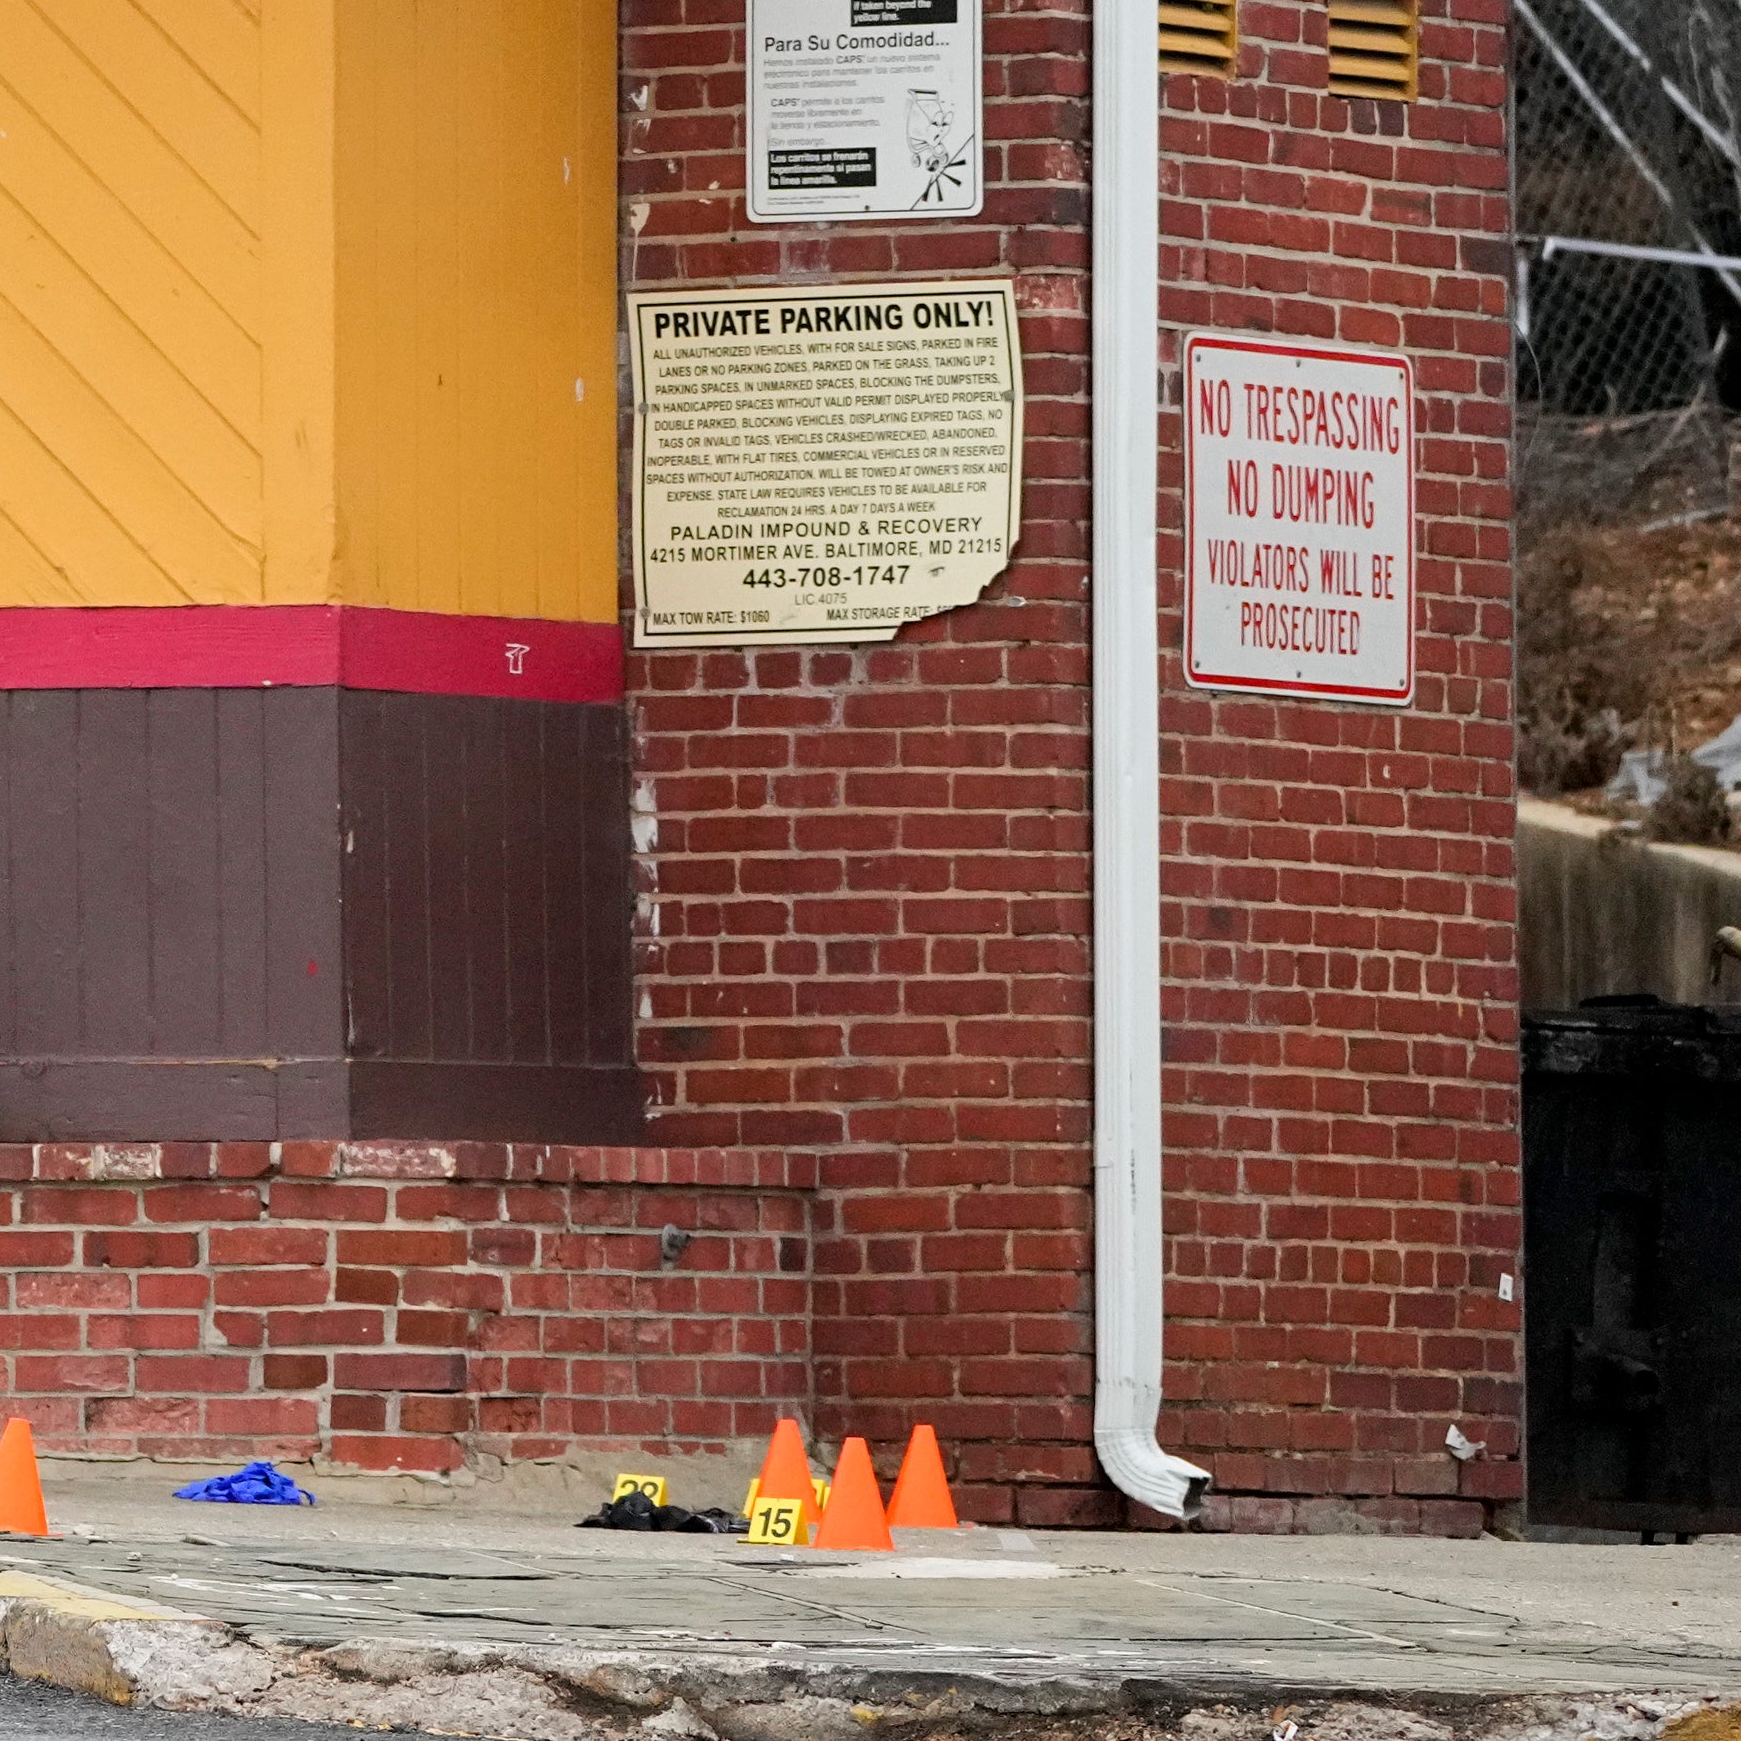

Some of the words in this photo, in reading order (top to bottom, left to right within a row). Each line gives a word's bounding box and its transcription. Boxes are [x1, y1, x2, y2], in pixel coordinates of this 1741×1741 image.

[764, 37, 802, 52] Para
[807, 36, 830, 51] Su
[835, 33, 949, 50] Comodidad...
[654, 310, 770, 339] PRIVATE
[780, 305, 903, 334] PARKING
[913, 302, 993, 329] ONLY!
[652, 349, 670, 360] ALL
[674, 346, 751, 359] UNAUTHORIZED
[807, 344, 832, 354] WITH
[834, 343, 855, 353] FOR
[857, 342, 883, 353] SALE
[921, 339, 961, 351] PARKED
[963, 339, 973, 349] IN
[975, 338, 999, 349] FIRE
[658, 367, 691, 378] LANES
[693, 366, 708, 377] OR
[710, 366, 725, 376] NO
[727, 364, 771, 376] PARKING
[812, 362, 852, 373] PARKED
[854, 361, 869, 371] ON
[873, 360, 891, 371] THE
[935, 358, 971, 369] TAKING
[973, 357, 986, 367] UP
[989, 357, 995, 367] 2
[655, 384, 698, 395] PARKING
[744, 382, 753, 392] IN
[756, 380, 812, 392] UNMARKED
[859, 377, 911, 388] BLOCKING
[915, 377, 933, 387] THE
[651, 404, 660, 414] IN
[662, 401, 732, 413] HANDICAPPED
[735, 400, 773, 411] SPACES
[776, 398, 820, 409] WITHOUT
[823, 397, 852, 408] VALID
[854, 396, 890, 406] PERMIT
[894, 394, 949, 405] DISPLAYED
[1200, 379, 1231, 438] NO
[1244, 383, 1401, 455] TRESPASSING
[1227, 460, 1259, 518] NO
[1272, 464, 1375, 529] DUMPING
[717, 506, 788, 518] RECLAMATION
[791, 506, 801, 516] 24
[830, 505, 836, 515] A
[839, 504, 858, 515] DAY
[862, 504, 866, 514] 7
[869, 503, 895, 514] DAYS
[898, 503, 904, 513] A
[906, 502, 935, 513] WEEK
[670, 525, 752, 541] PALADIN
[760, 522, 850, 538] IMPOUND
[858, 521, 869, 535] &
[877, 518, 982, 534] RECOVERY
[650, 549, 685, 563] 4215
[691, 546, 777, 561] MORTIMER
[929, 541, 952, 554] MD
[958, 539, 1001, 553] 21215
[742, 566, 910, 588] 443-708-1747
[1207, 539, 1310, 593] VIOLATORS
[1320, 550, 1363, 597] WILL
[1372, 554, 1395, 600] BE
[794, 595, 815, 606] LIC
[817, 594, 847, 605] 4075
[652, 614, 675, 625] MAX
[679, 613, 703, 625] TOW
[706, 612, 736, 624] RATE:
[740, 611, 769, 623] $1060
[826, 610, 848, 621] MAX
[851, 608, 899, 620] STORAGE
[1241, 602, 1361, 656] PROSECUTED
[759, 1508, 793, 1538] 15
